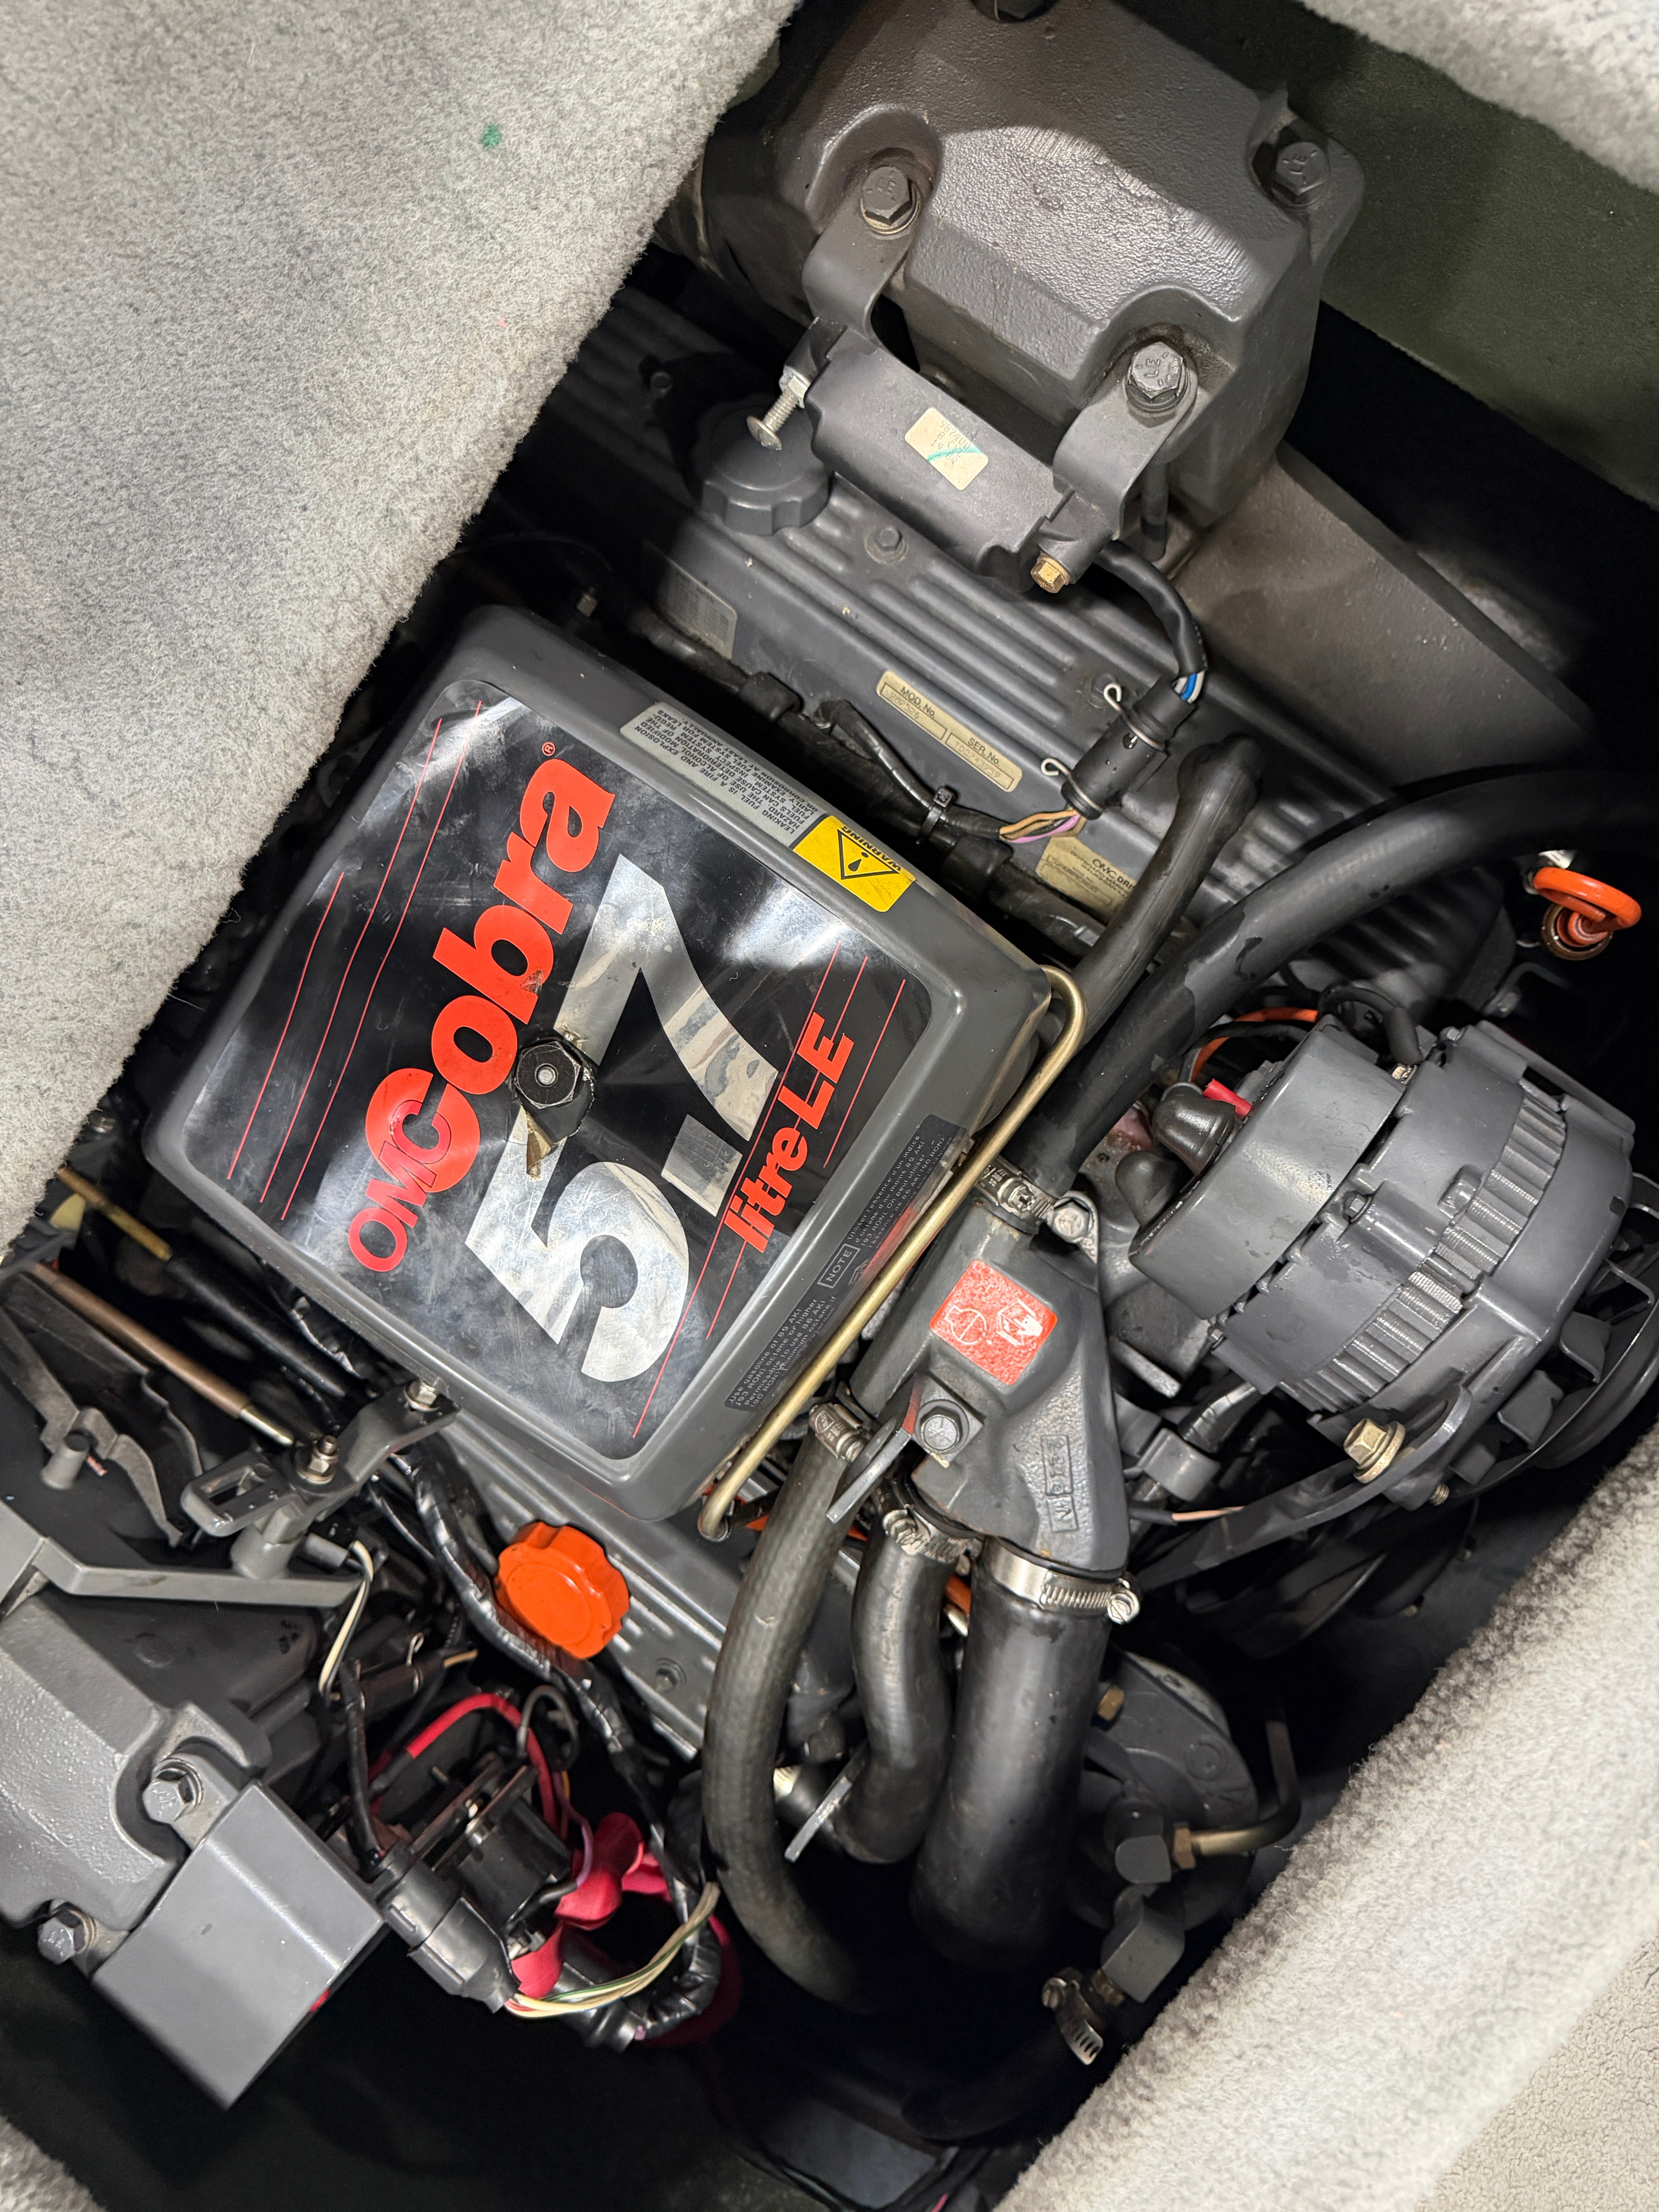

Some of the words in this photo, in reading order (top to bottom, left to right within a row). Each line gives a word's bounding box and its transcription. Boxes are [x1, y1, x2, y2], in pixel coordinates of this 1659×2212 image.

[939, 419, 972, 450] 987400
[646, 717, 662, 729] THE
[652, 714, 677, 730] REGU-
[657, 709, 682, 726] LEAKS
[900, 686, 922, 707] MOD.
[923, 704, 936, 718] No.
[967, 737, 986, 756] SER.
[987, 752, 1000, 766] No.
[634, 725, 679, 755] EXPLOSION
[640, 721, 678, 747] MODIFIED
[661, 728, 675, 737] OF
[680, 731, 712, 753] SYSTEM
[682, 726, 699, 737] FOR
[675, 735, 735, 776] DETERIORATION
[682, 747, 716, 771] ALCOHOL
[700, 737, 731, 758] SYSTEM
[723, 747, 748, 763] LEAST
[680, 755, 699, 767] AND
[715, 754, 748, 778] INSPECT
[733, 758, 751, 772] FUEL
[699, 768, 718, 781] FIRE
[716, 772, 729, 780] OF
[730, 780, 747, 792] USE
[735, 776, 762, 795] CAUSE
[751, 771, 786, 795] EXAMINE
[760, 771, 805, 802] CORROSION
[740, 794, 760, 809] FUEL
[747, 792, 763, 804] THE
[754, 779, 786, 803] SYSTEM.
[762, 794, 779, 807] CAN
[768, 804, 800, 829] HAZARD.
[780, 806, 805, 824] FUELS
[788, 795, 814, 815] LARLY.
[790, 804, 810, 819] FUEL
[805, 802, 817, 811] OR
[761, 809, 795, 833] LEAKING
[841, 825, 901, 871] WARNING
[1091, 858, 1118, 879] OMC
[1116, 875, 1135, 891] DRI
[366, 759, 615, 1193] Cobra
[464, 854, 779, 1382] 5.7
[723, 1126, 807, 1253] litre
[778, 1012, 854, 1130] LE
[890, 1170, 905, 1192] moins
[905, 1157, 915, 1168] 89
[914, 1141, 925, 1154] AKI
[348, 1099, 452, 1272] OMC
[847, 1214, 867, 1240] Utiliser
[902, 1135, 920, 1158] indice
[894, 1201, 902, 1211] de
[910, 1174, 921, 1186] AKI
[920, 1158, 931, 1171] (90
[860, 1232, 872, 1246] (93
[886, 1198, 896, 1209] On
[895, 1179, 908, 1197] peut
[907, 1154, 925, 1178] utiliser
[825, 1249, 852, 1281] NOTE
[730, 1386, 744, 1401] Use
[743, 1351, 770, 1385] gasoline
[769, 1339, 778, 1349] of
[778, 1325, 789, 1338] 89
[788, 1308, 801, 1323] AKI
[744, 1359, 781, 1405] Permissible
[780, 1348, 790, 1357] to
[789, 1331, 802, 1346] use
[801, 1317, 813, 1329] 86
[812, 1300, 826, 1315] AKI
[747, 1367, 766, 1389] RON)
[766, 1337, 788, 1366] octane
[788, 1325, 797, 1336] or
[795, 1298, 817, 1324] higher
[750, 1393, 763, 1407] (90
[762, 1370, 780, 1391] RON)
[808, 1304, 830, 1332] octane
